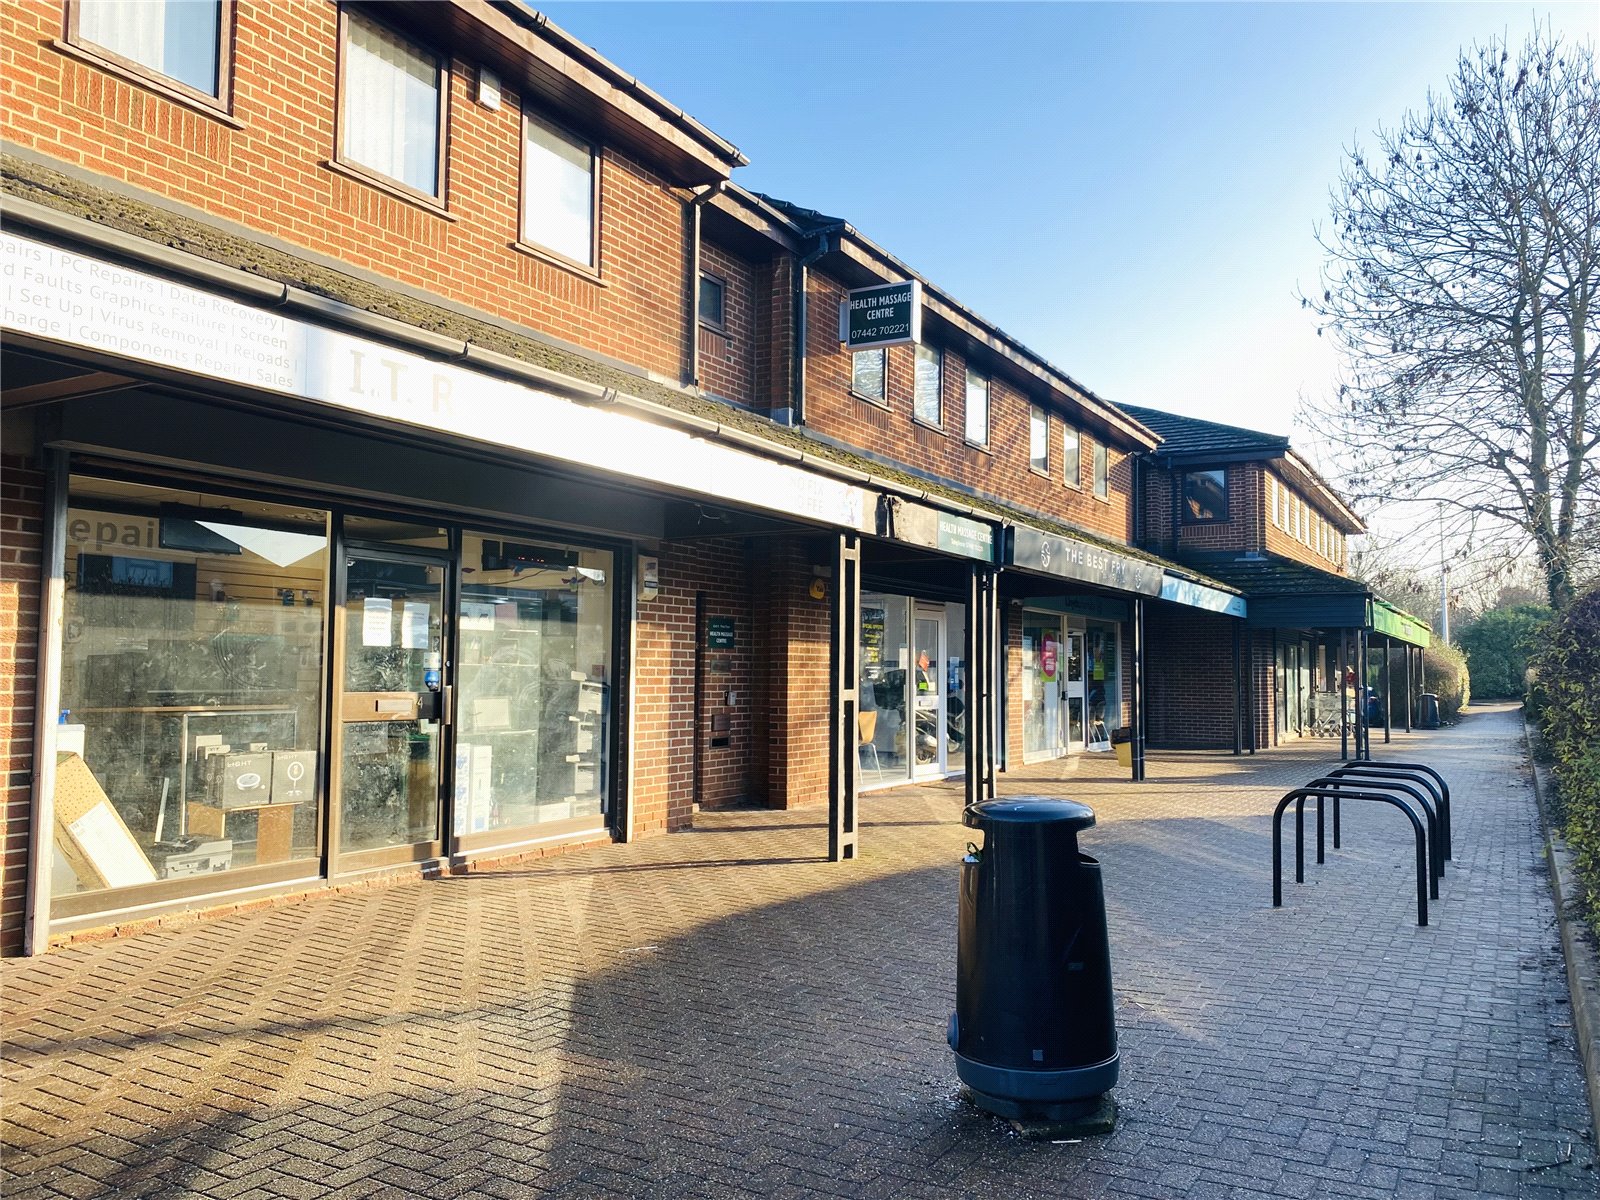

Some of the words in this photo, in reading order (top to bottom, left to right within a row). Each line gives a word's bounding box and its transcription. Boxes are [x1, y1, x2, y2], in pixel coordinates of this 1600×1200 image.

[0, 240, 42, 262] airs
[61, 255, 83, 273] PC
[90, 263, 154, 293] Repairs
[170, 286, 206, 307] Data
[212, 299, 278, 331] Recovery
[0, 262, 15, 276] d
[23, 266, 83, 295] Faults
[90, 285, 165, 317] Graphics
[171, 306, 226, 334] Failure
[240, 326, 288, 351] Screen
[850, 297, 877, 310] HEALTH
[879, 291, 912, 306] MASSAGE
[866, 307, 894, 321] CENTRE
[20, 288, 51, 309] Set
[59, 298, 83, 318] Up
[100, 308, 144, 332] Virus
[151, 322, 218, 351] Removal
[234, 343, 290, 369] Reloads
[851, 327, 877, 339] 07442
[880, 323, 909, 335] 702221
[0, 306, 61, 333] harge
[79, 325, 188, 362] Components
[195, 353, 241, 376] Repair
[256, 368, 294, 388] Sales
[939, 521, 957, 535] HEALTH
[977, 531, 992, 545] CENTRE
[1065, 548, 1084, 565] THE
[1087, 554, 1109, 571] BEST
[1111, 560, 1126, 575] FRY
